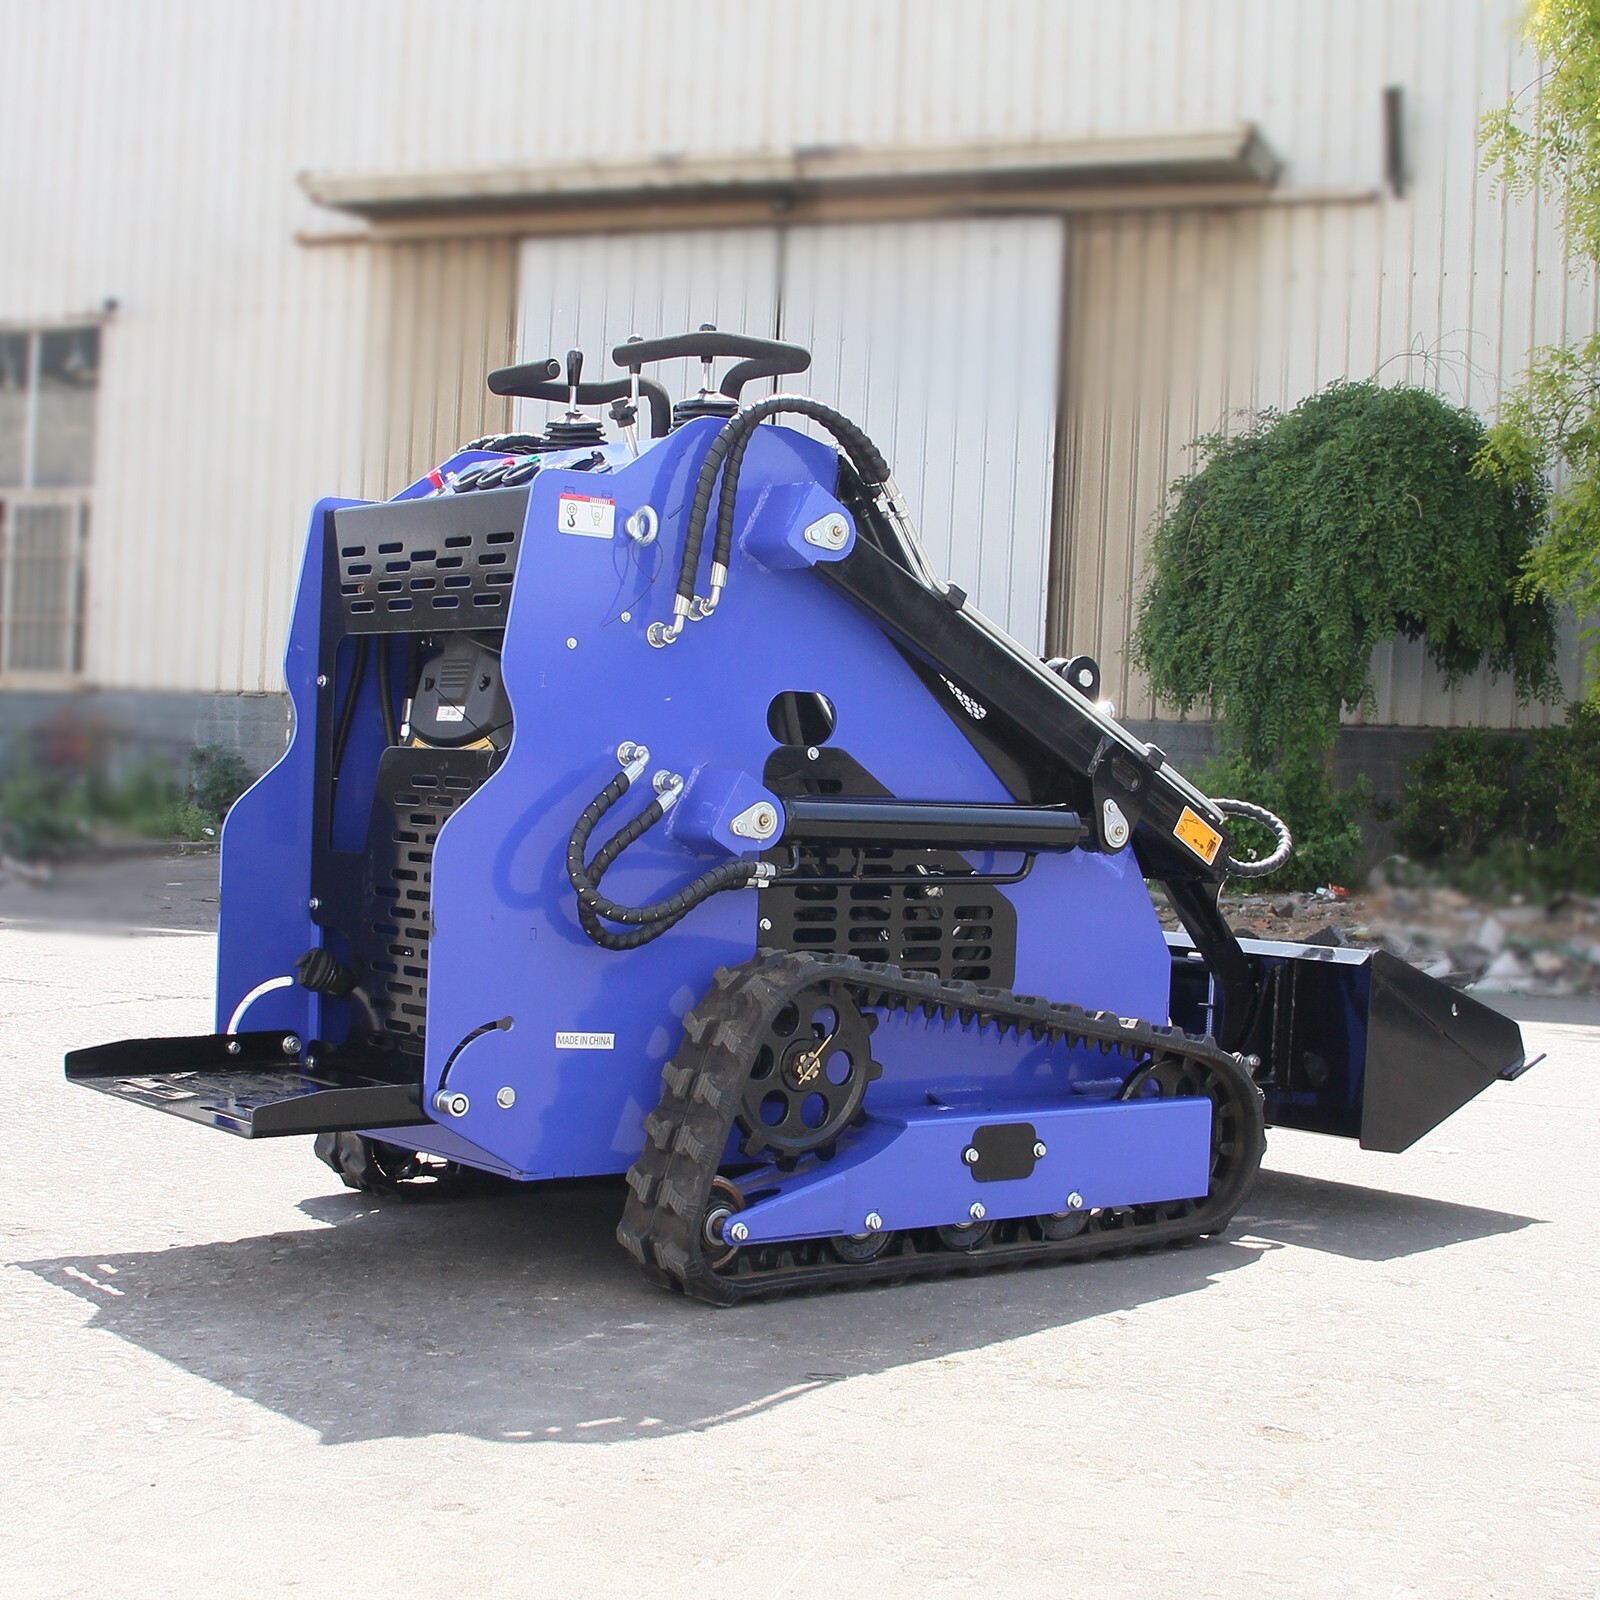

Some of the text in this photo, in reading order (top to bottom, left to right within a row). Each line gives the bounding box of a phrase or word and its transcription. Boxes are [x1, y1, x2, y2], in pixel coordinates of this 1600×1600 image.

[557, 1035, 611, 1045] MADE IN CHINA
